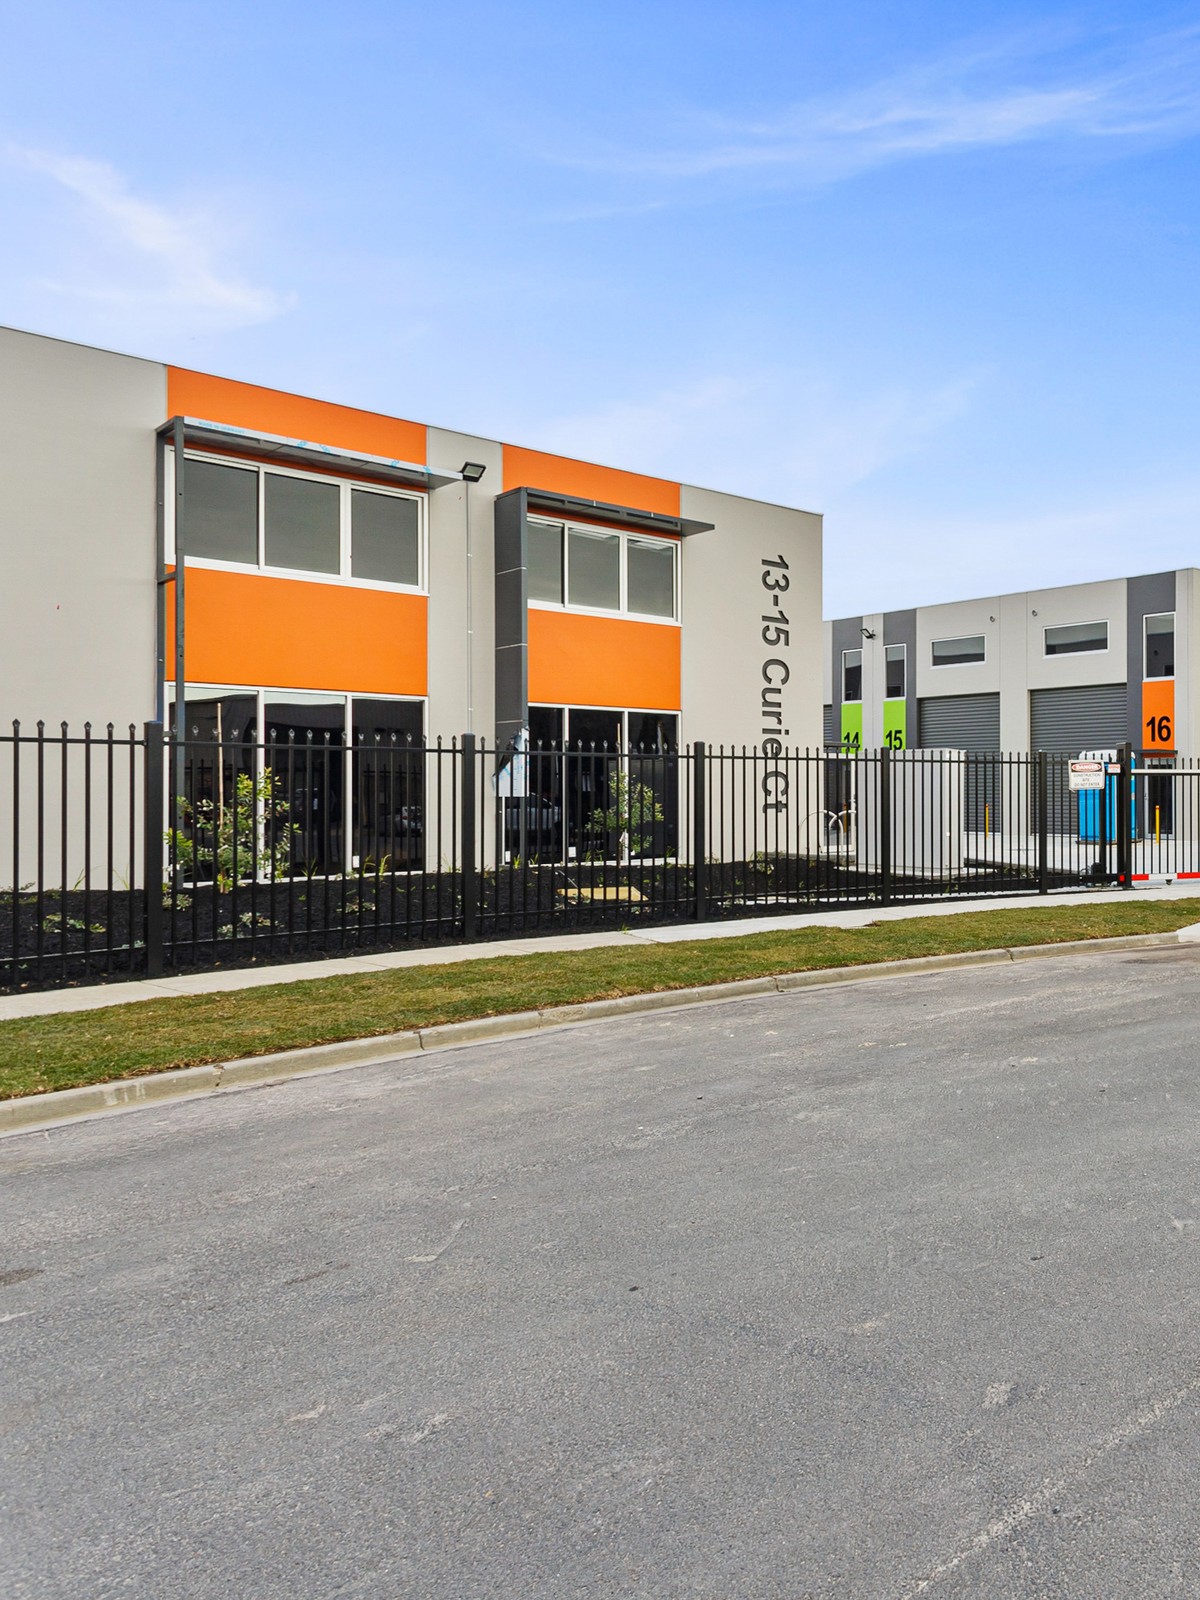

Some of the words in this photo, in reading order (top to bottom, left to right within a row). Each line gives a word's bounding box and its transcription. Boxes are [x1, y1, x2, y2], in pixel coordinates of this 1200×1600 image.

[761, 554, 790, 647] 13-15
[761, 658, 790, 758] Curie
[843, 732, 861, 752] 14
[885, 730, 903, 750] 15
[1146, 716, 1171, 742] 16
[761, 771, 789, 814] Ct
